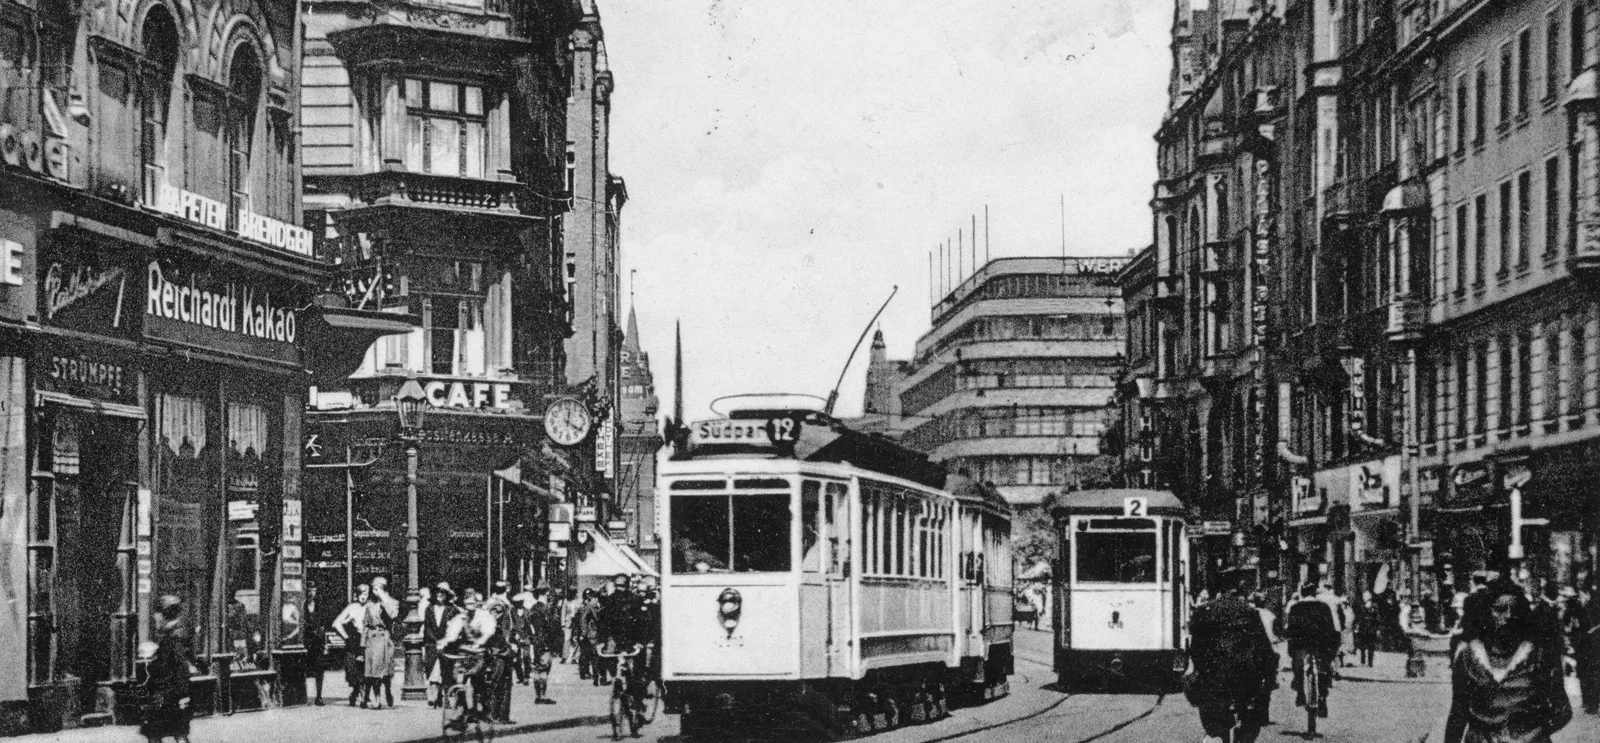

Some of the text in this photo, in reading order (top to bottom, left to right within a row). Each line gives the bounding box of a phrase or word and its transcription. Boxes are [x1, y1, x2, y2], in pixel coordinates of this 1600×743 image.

[239, 208, 313, 257] BRENDGEN
[1078, 259, 1127, 273] WER
[147, 260, 237, 332] Reichardt
[242, 284, 296, 343] Kakao
[50, 355, 122, 387] STRÜMPFE
[425, 380, 511, 409] CAFE
[772, 418, 794, 441] 12
[1130, 499, 1142, 516] 2
